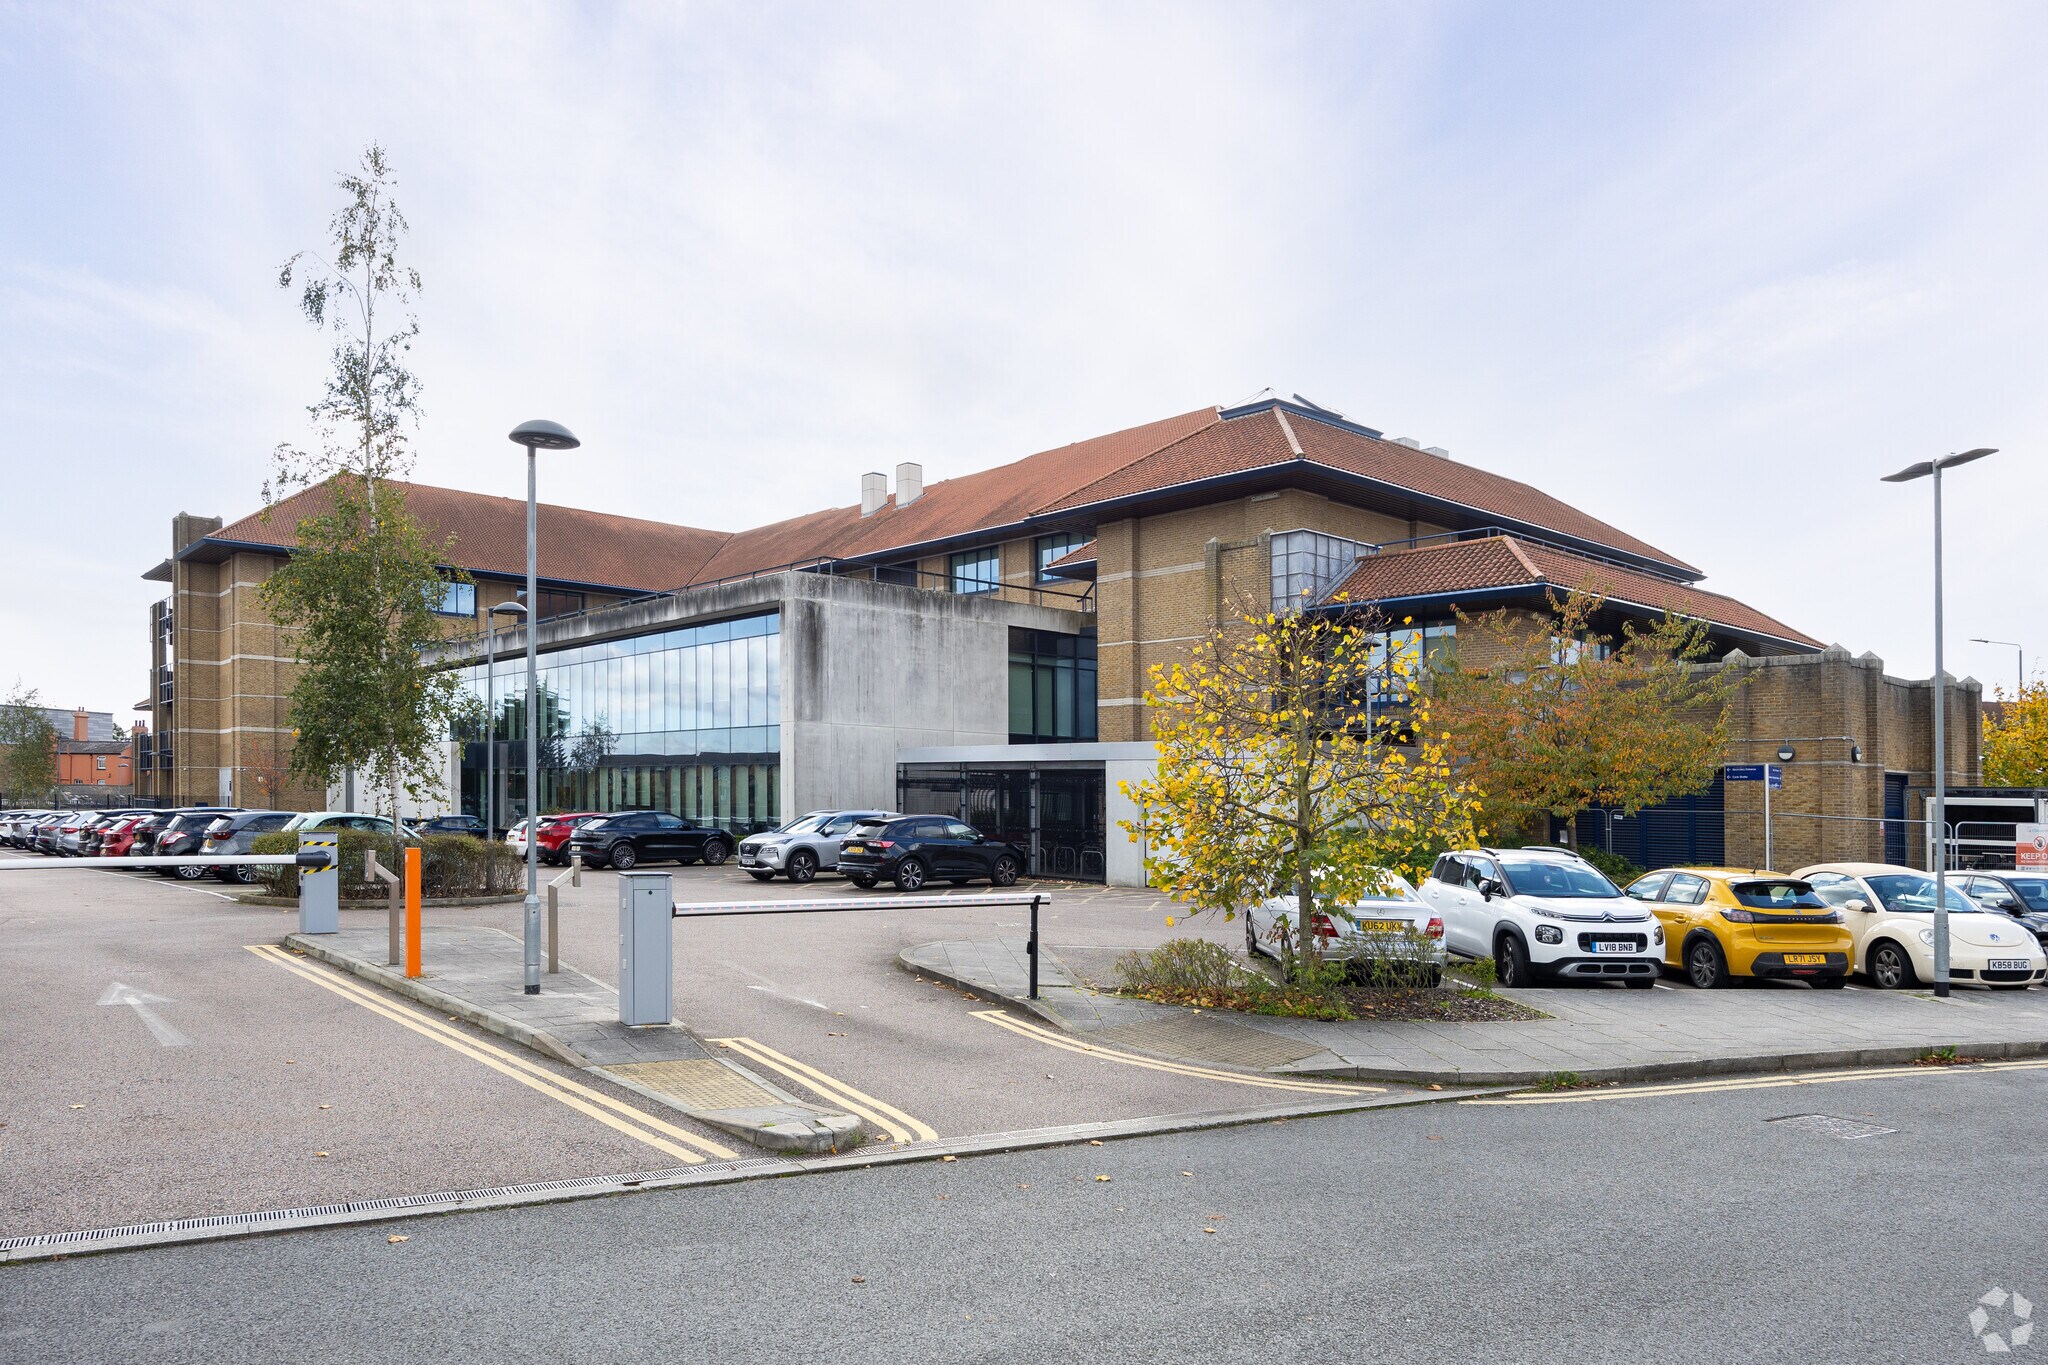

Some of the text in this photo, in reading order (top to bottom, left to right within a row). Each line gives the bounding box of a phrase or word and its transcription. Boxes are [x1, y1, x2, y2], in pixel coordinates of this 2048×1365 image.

[2020, 852, 2041, 860] KEEP
[1362, 921, 1384, 930] KU62
[1598, 943, 1633, 952] LV18 BNB
[1787, 954, 1821, 963] LR71 JSY
[1992, 961, 2028, 969] KB58 BUG
